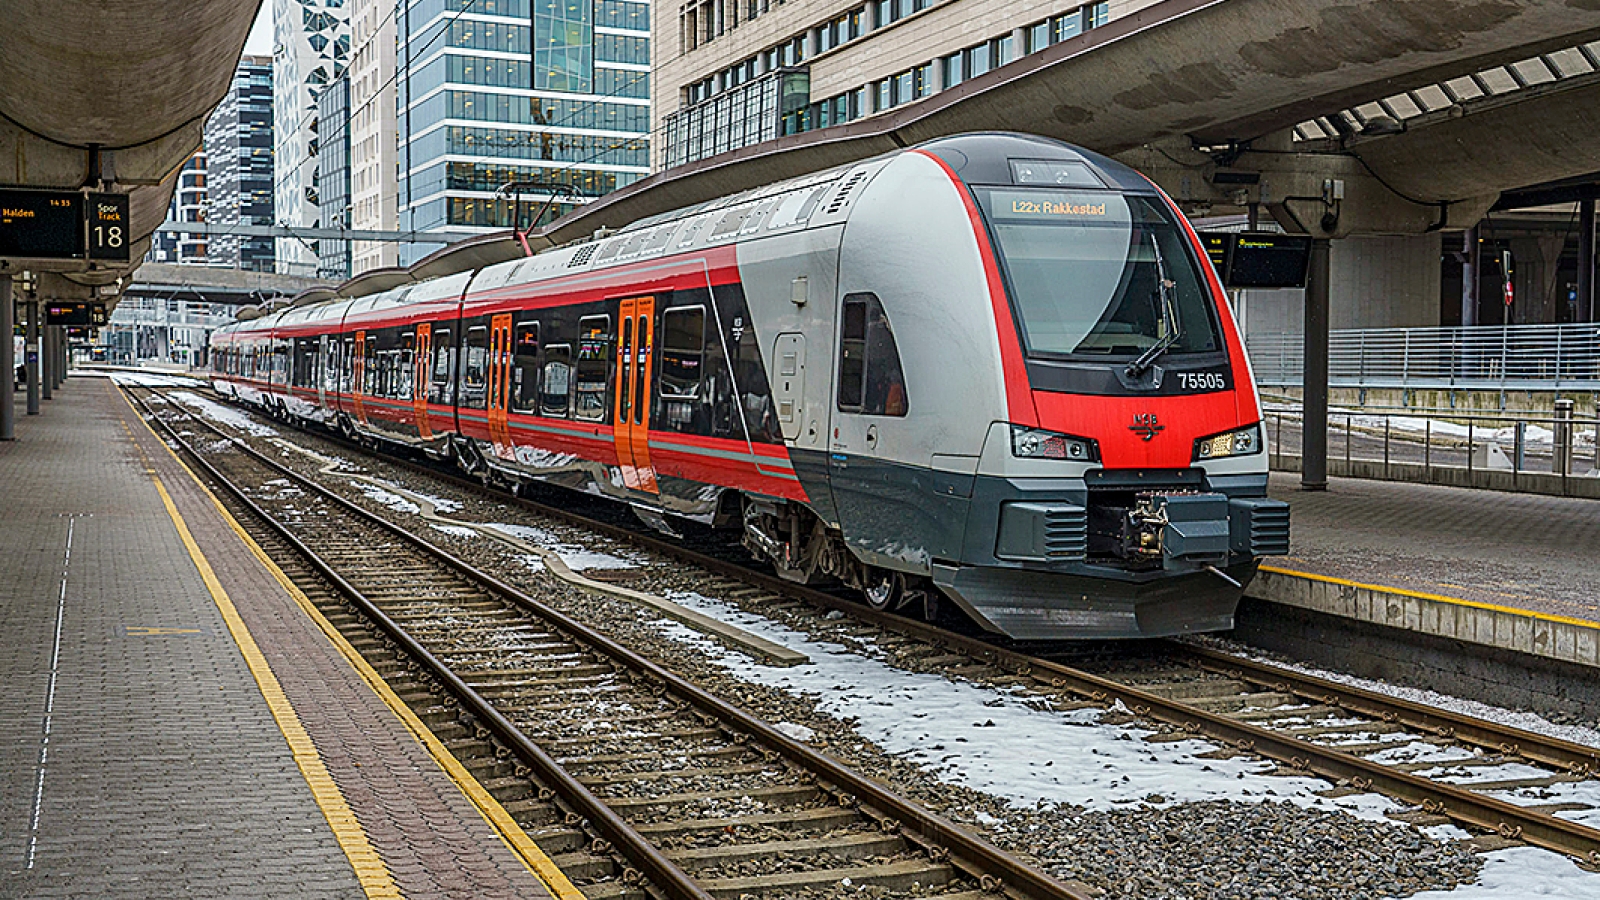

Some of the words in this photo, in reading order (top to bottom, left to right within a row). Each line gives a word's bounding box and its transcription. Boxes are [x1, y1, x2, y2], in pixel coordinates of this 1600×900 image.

[2, 208, 35, 218] Halden
[97, 203, 118, 212] Spor
[1012, 200, 1041, 213] L22x
[1043, 201, 1106, 216] Rakkestad
[98, 212, 121, 220] Track
[94, 225, 123, 248] 18
[1176, 372, 1226, 389] 75505
[1133, 413, 1158, 424] NSB
